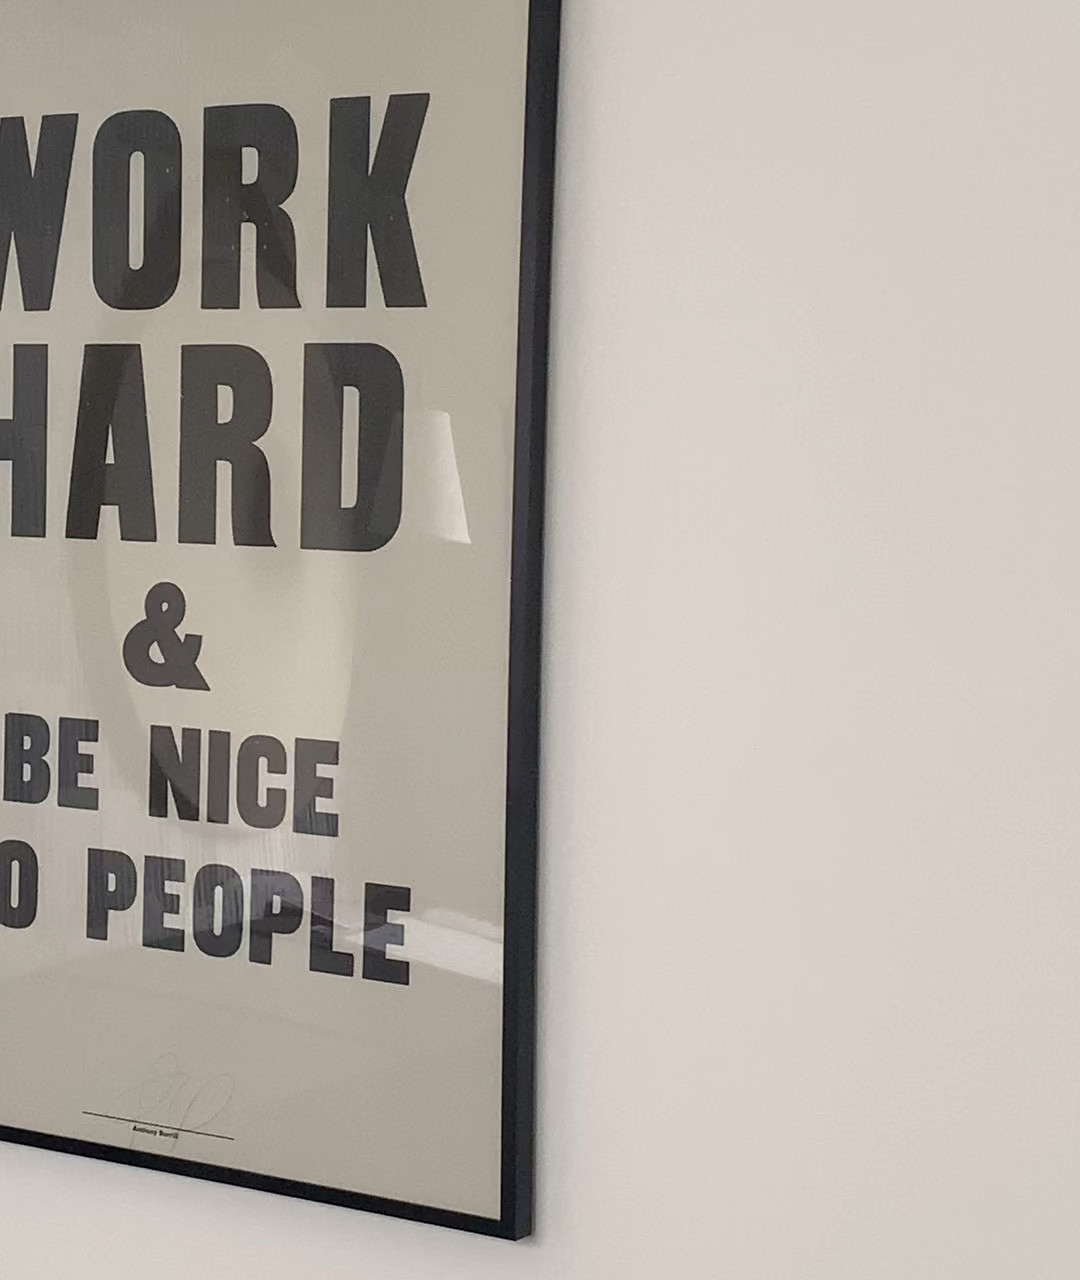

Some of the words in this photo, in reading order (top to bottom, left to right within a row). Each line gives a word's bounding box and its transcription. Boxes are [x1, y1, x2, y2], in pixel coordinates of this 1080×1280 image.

[122, 581, 211, 692] &
[2, 712, 100, 811] BE
[148, 724, 340, 838] NICE
[86, 847, 412, 987] PEOPLE
